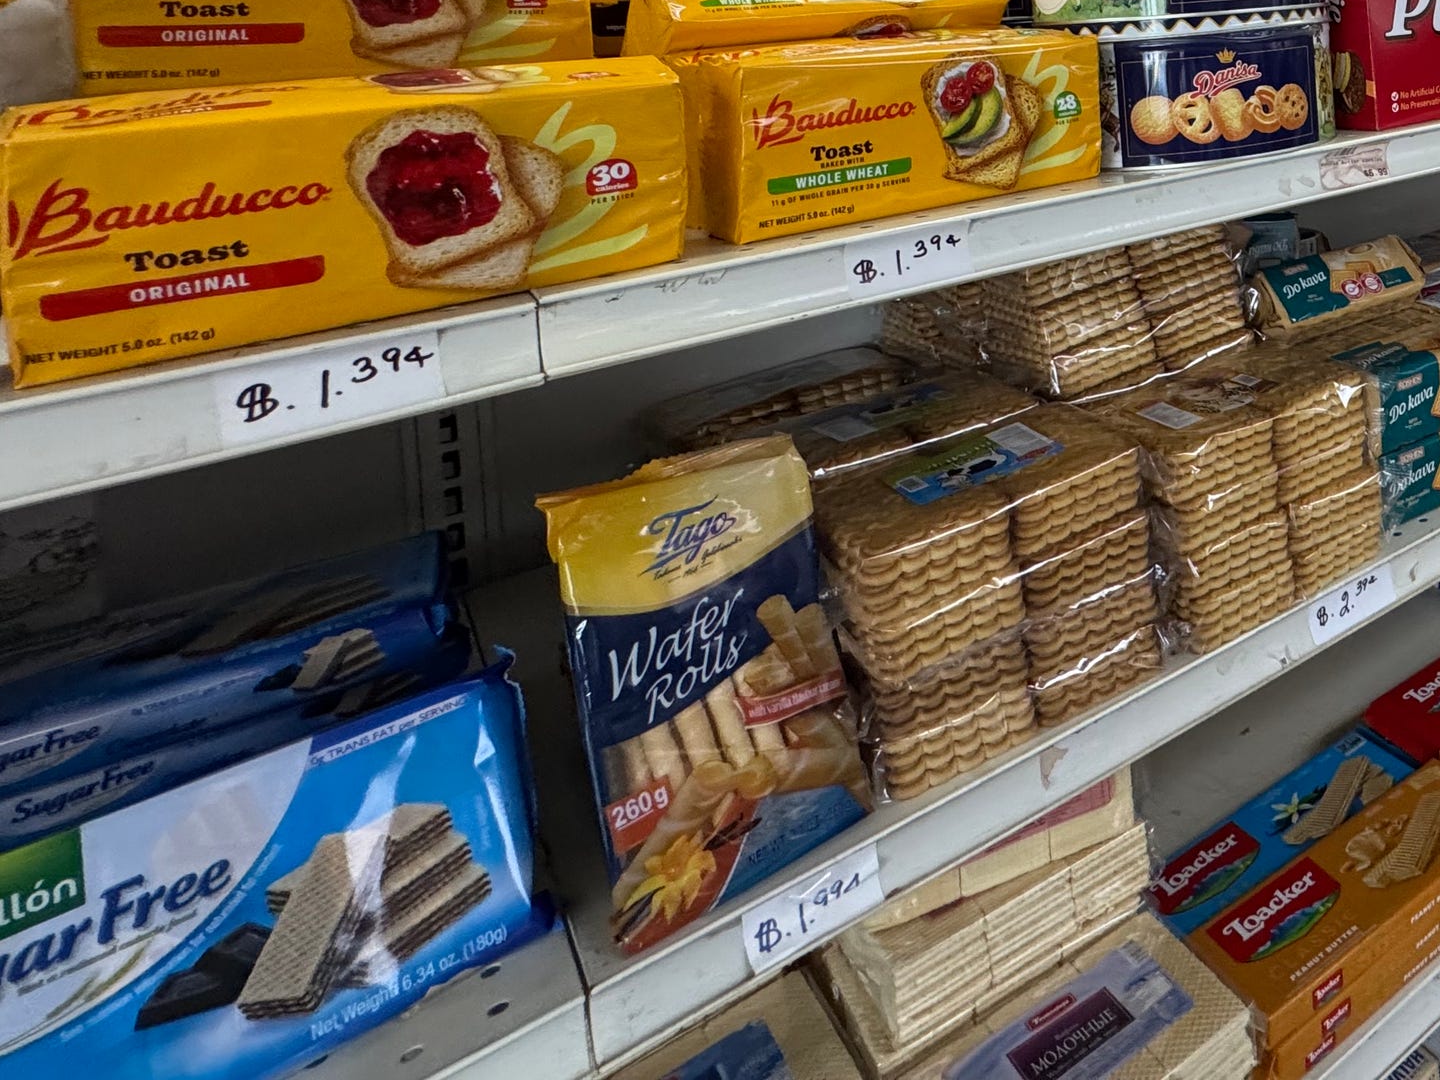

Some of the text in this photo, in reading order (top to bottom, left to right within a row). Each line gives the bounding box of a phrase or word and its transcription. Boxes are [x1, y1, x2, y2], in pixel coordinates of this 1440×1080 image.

[159, 1, 250, 18] Toast
[161, 29, 249, 42] ORIGINAL
[105, 70, 148, 80] WEIGHT
[1190, 60, 1262, 99] Danisa
[1056, 94, 1078, 112] 28
[1400, 91, 1409, 100] No
[1410, 86, 1434, 99] Artificial
[1400, 101, 1409, 111] No
[752, 93, 917, 150] Bauducco
[810, 139, 874, 161] Toast
[820, 156, 865, 169] BAKED WITH
[592, 162, 631, 186] 30
[796, 163, 889, 189] WHOLE WHEAT
[798, 191, 824, 203] WHOLE
[825, 186, 849, 198] GRAIN
[8, 177, 333, 261] Bauducco
[758, 204, 855, 229] NET WEIGHT 5.0 oz. (142 g)
[124, 240, 249, 272] Toast
[130, 272, 251, 303] ORIGINAL
[1283, 271, 1327, 300] Do kava
[25, 327, 216, 365] NET WEIGHT 5.0 oz. (142 g)
[1389, 386, 1435, 425] Do kava
[1389, 460, 1436, 497] Do kava
[637, 495, 738, 578] Tago
[608, 587, 745, 703] Wafer
[645, 631, 748, 725] Rolls
[328, 735, 371, 760] TRANS
[373, 725, 396, 741] FAT
[13, 759, 155, 822] SugarFree
[611, 784, 671, 832] 260 g
[1150, 833, 1239, 897] Loacker
[1222, 871, 1314, 943] Loacker
[1410, 900, 1437, 925] PEANUT
[1289, 924, 1360, 983] PEANUT BUTTER
[309, 1018, 341, 1041] Net
[401, 961, 437, 994] 6.34
[437, 953, 461, 977] oz.
[462, 925, 509, 963] (180g)
[1029, 1006, 1118, 1077] МОЛОЧНЫЕ
